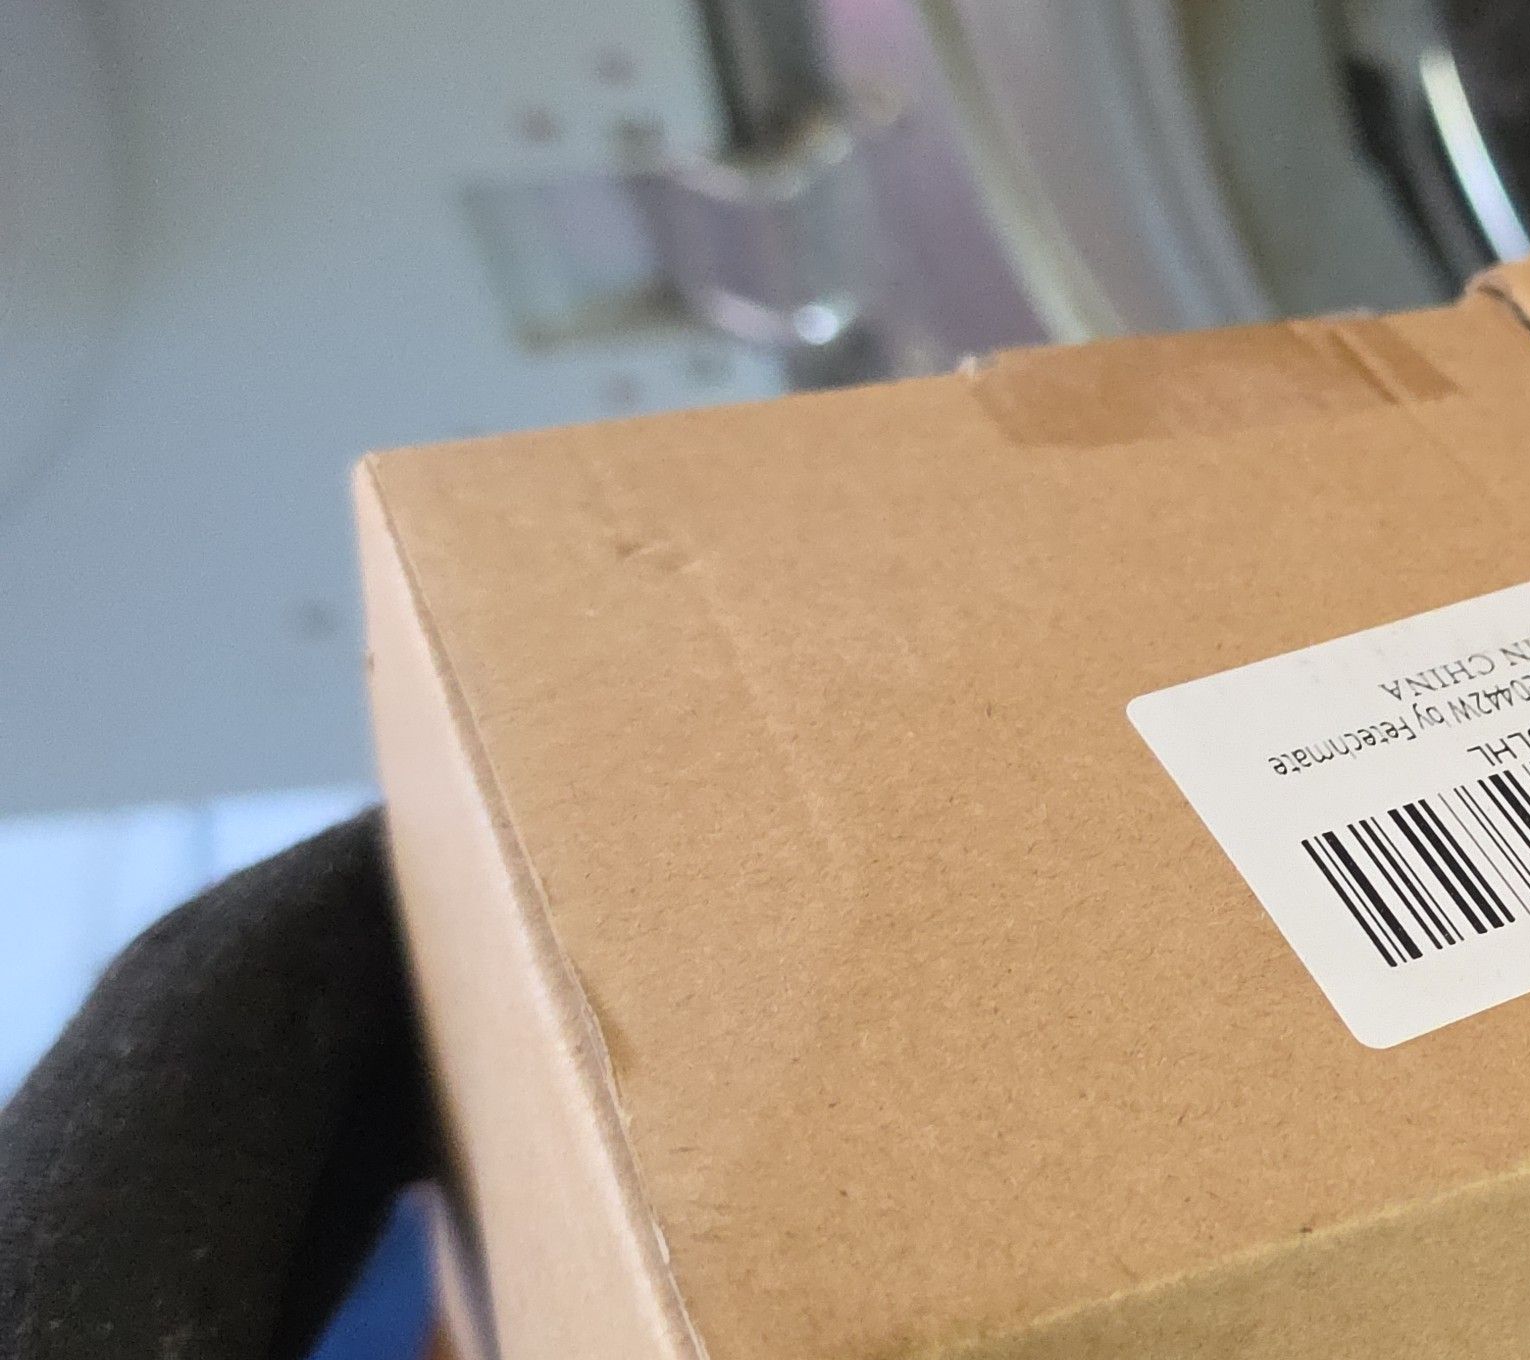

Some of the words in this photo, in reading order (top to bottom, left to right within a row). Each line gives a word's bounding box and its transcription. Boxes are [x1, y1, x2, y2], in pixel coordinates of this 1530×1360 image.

[1378, 653, 1496, 701] CHINA
[1412, 702, 1452, 730] by
[1268, 716, 1417, 776] Fetechmate
